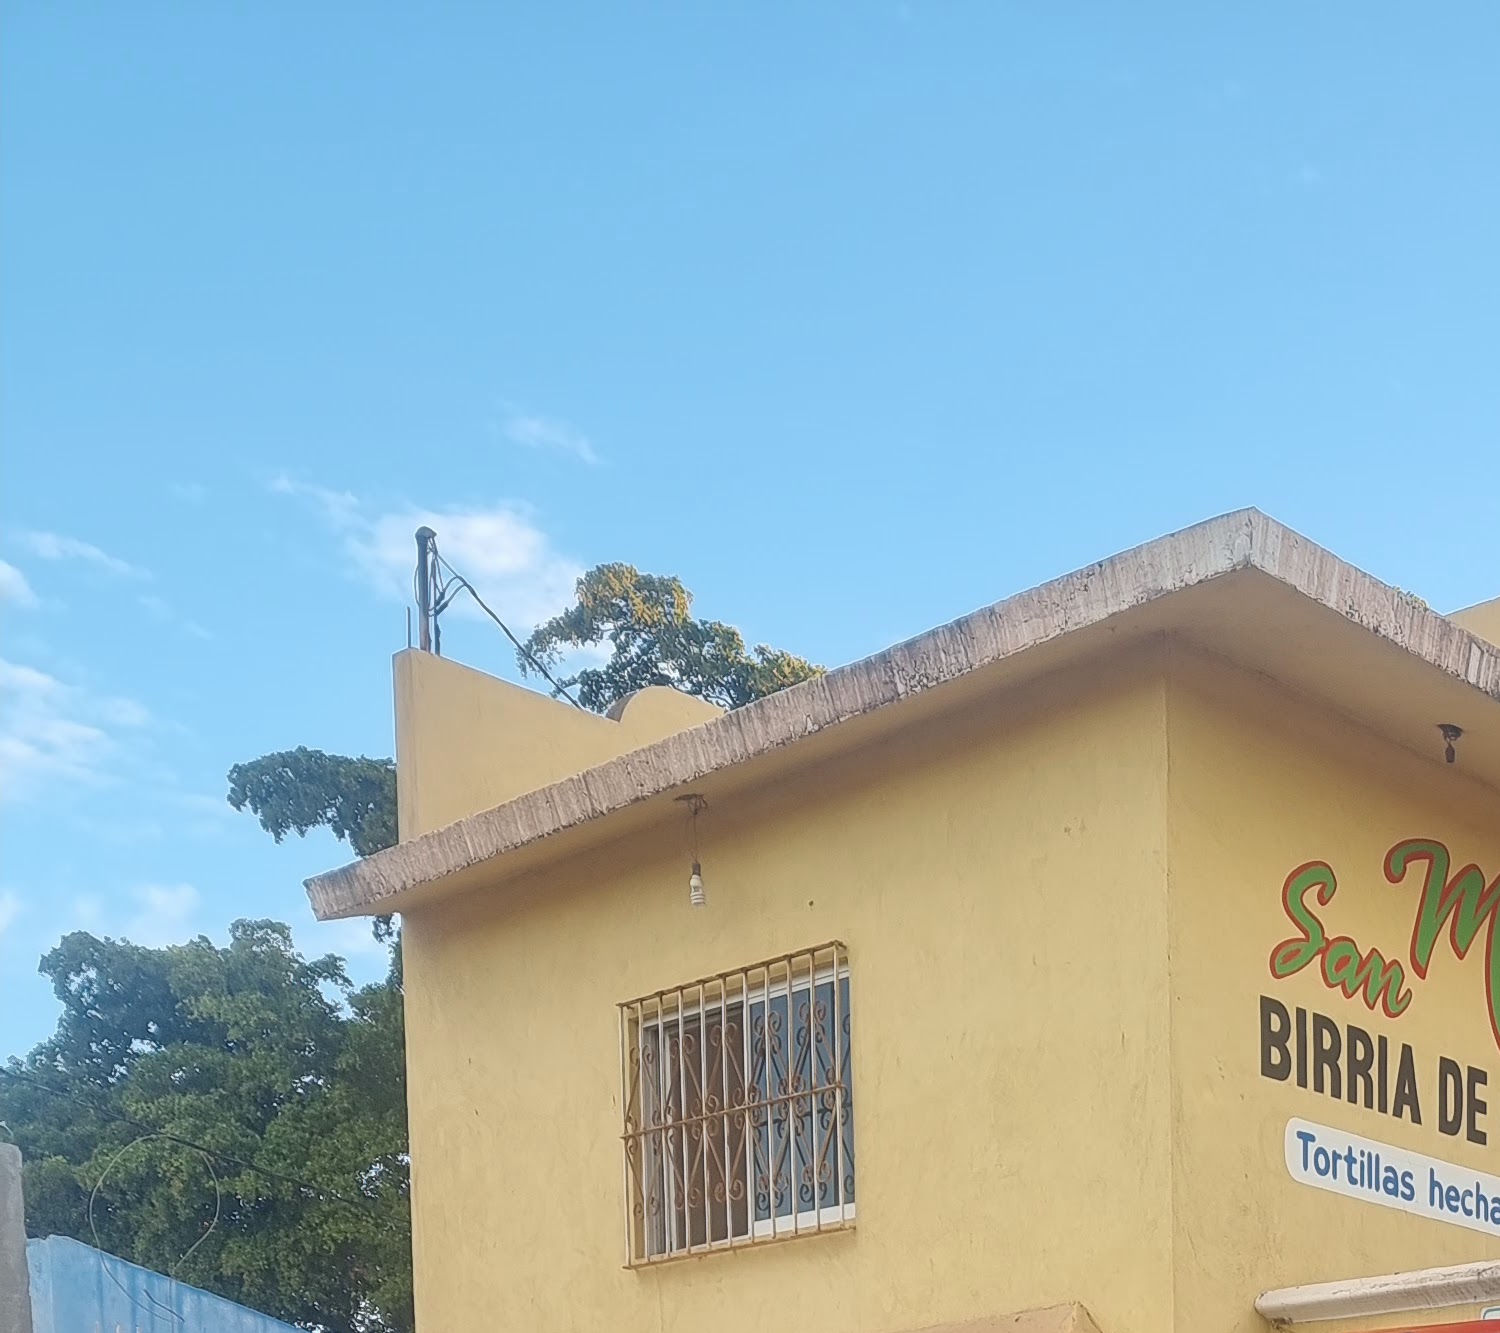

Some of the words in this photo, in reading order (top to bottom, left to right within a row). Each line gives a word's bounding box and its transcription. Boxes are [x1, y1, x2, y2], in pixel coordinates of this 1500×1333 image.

[1270, 860, 1413, 1018] San
[1259, 994, 1423, 1126] BIRRIA
[1438, 1055, 1488, 1146] DE
[1296, 1130, 1416, 1201] Tortillas
